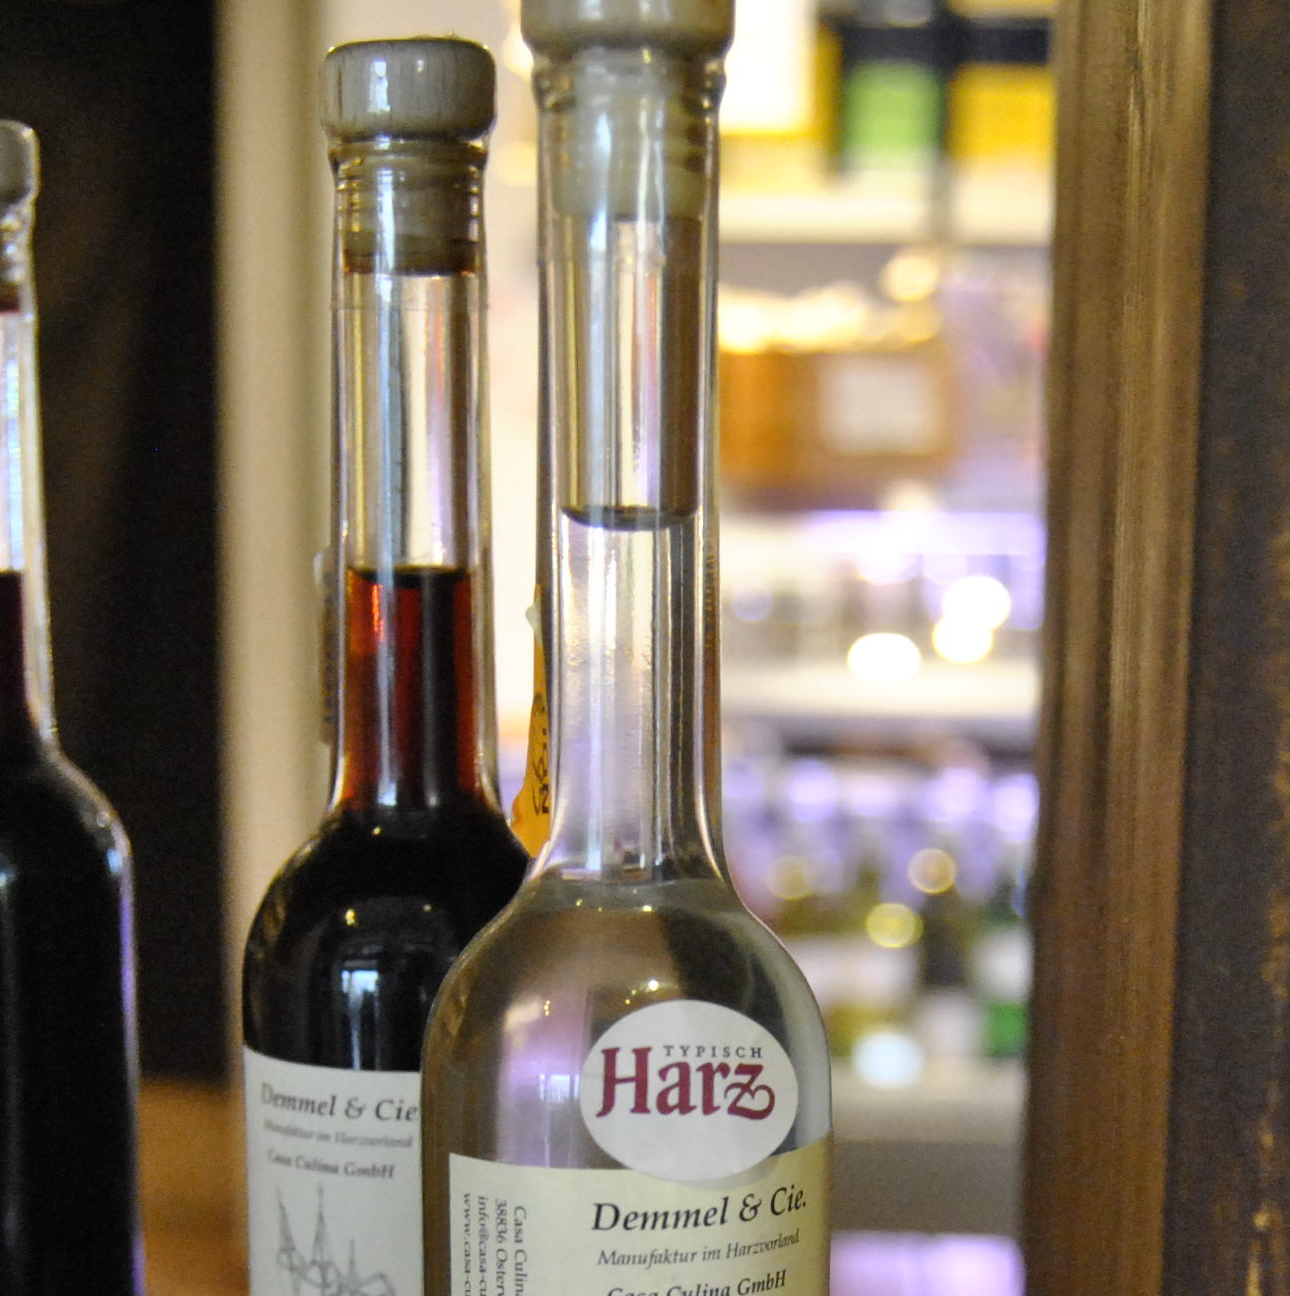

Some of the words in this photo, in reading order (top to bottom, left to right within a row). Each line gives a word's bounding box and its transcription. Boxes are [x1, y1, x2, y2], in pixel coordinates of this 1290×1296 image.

[663, 1045, 763, 1059] TYPISCH
[595, 1047, 776, 1121] Harz
[345, 1096, 365, 1119] &
[495, 1199, 508, 1243] 38836
[514, 1206, 527, 1243] Casa
[591, 1196, 729, 1231] Demmel
[739, 1194, 762, 1222] &
[770, 1184, 807, 1216] Cie.
[597, 1249, 697, 1270] Manufaktur
[702, 1246, 721, 1262] im
[726, 1228, 800, 1259] Harzvorland
[737, 1269, 786, 1296] GmbH
